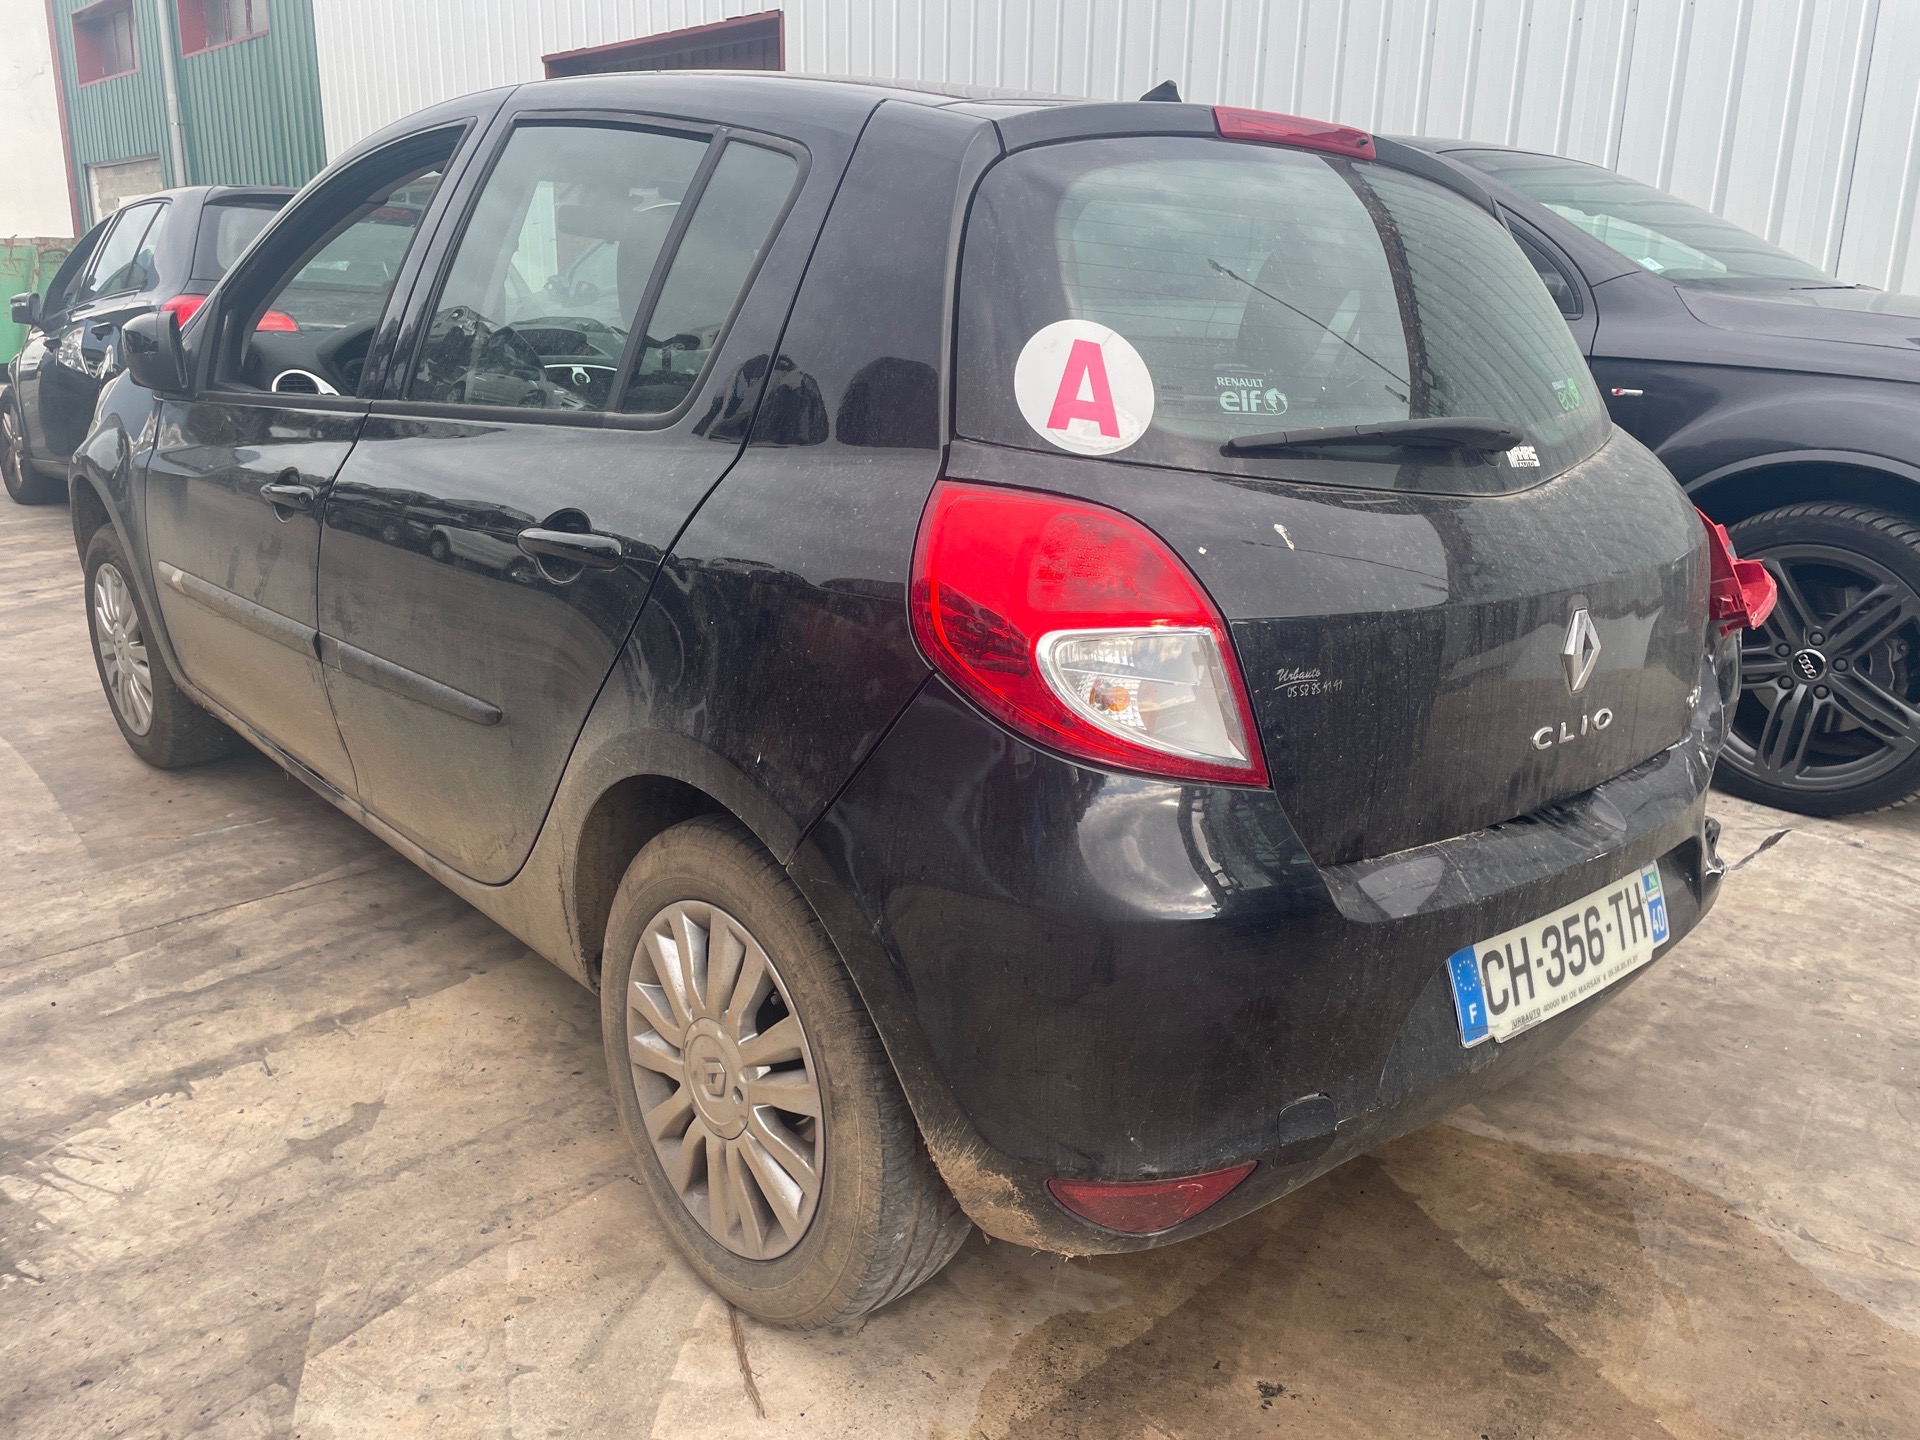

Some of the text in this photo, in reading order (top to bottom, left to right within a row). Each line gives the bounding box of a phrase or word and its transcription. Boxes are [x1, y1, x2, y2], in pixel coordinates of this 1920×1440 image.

[1047, 339, 1121, 438] A
[1216, 376, 1264, 388] RENAULT
[1219, 390, 1262, 412] elf
[1276, 667, 1321, 682] Urbauto
[1287, 686, 1298, 698] 05
[1300, 684, 1309, 697] 58
[1311, 682, 1321, 695] 85
[1532, 707, 1613, 750] CLIO
[1651, 904, 1665, 935] 40
[1481, 882, 1648, 1016] CH-356-TH
[1468, 1003, 1478, 1024] F
[1512, 1007, 1541, 1028] URBAUTO
[1543, 998, 1560, 1012] 40000
[1569, 989, 1578, 1000] DE
[1578, 976, 1601, 994] MARSAN
